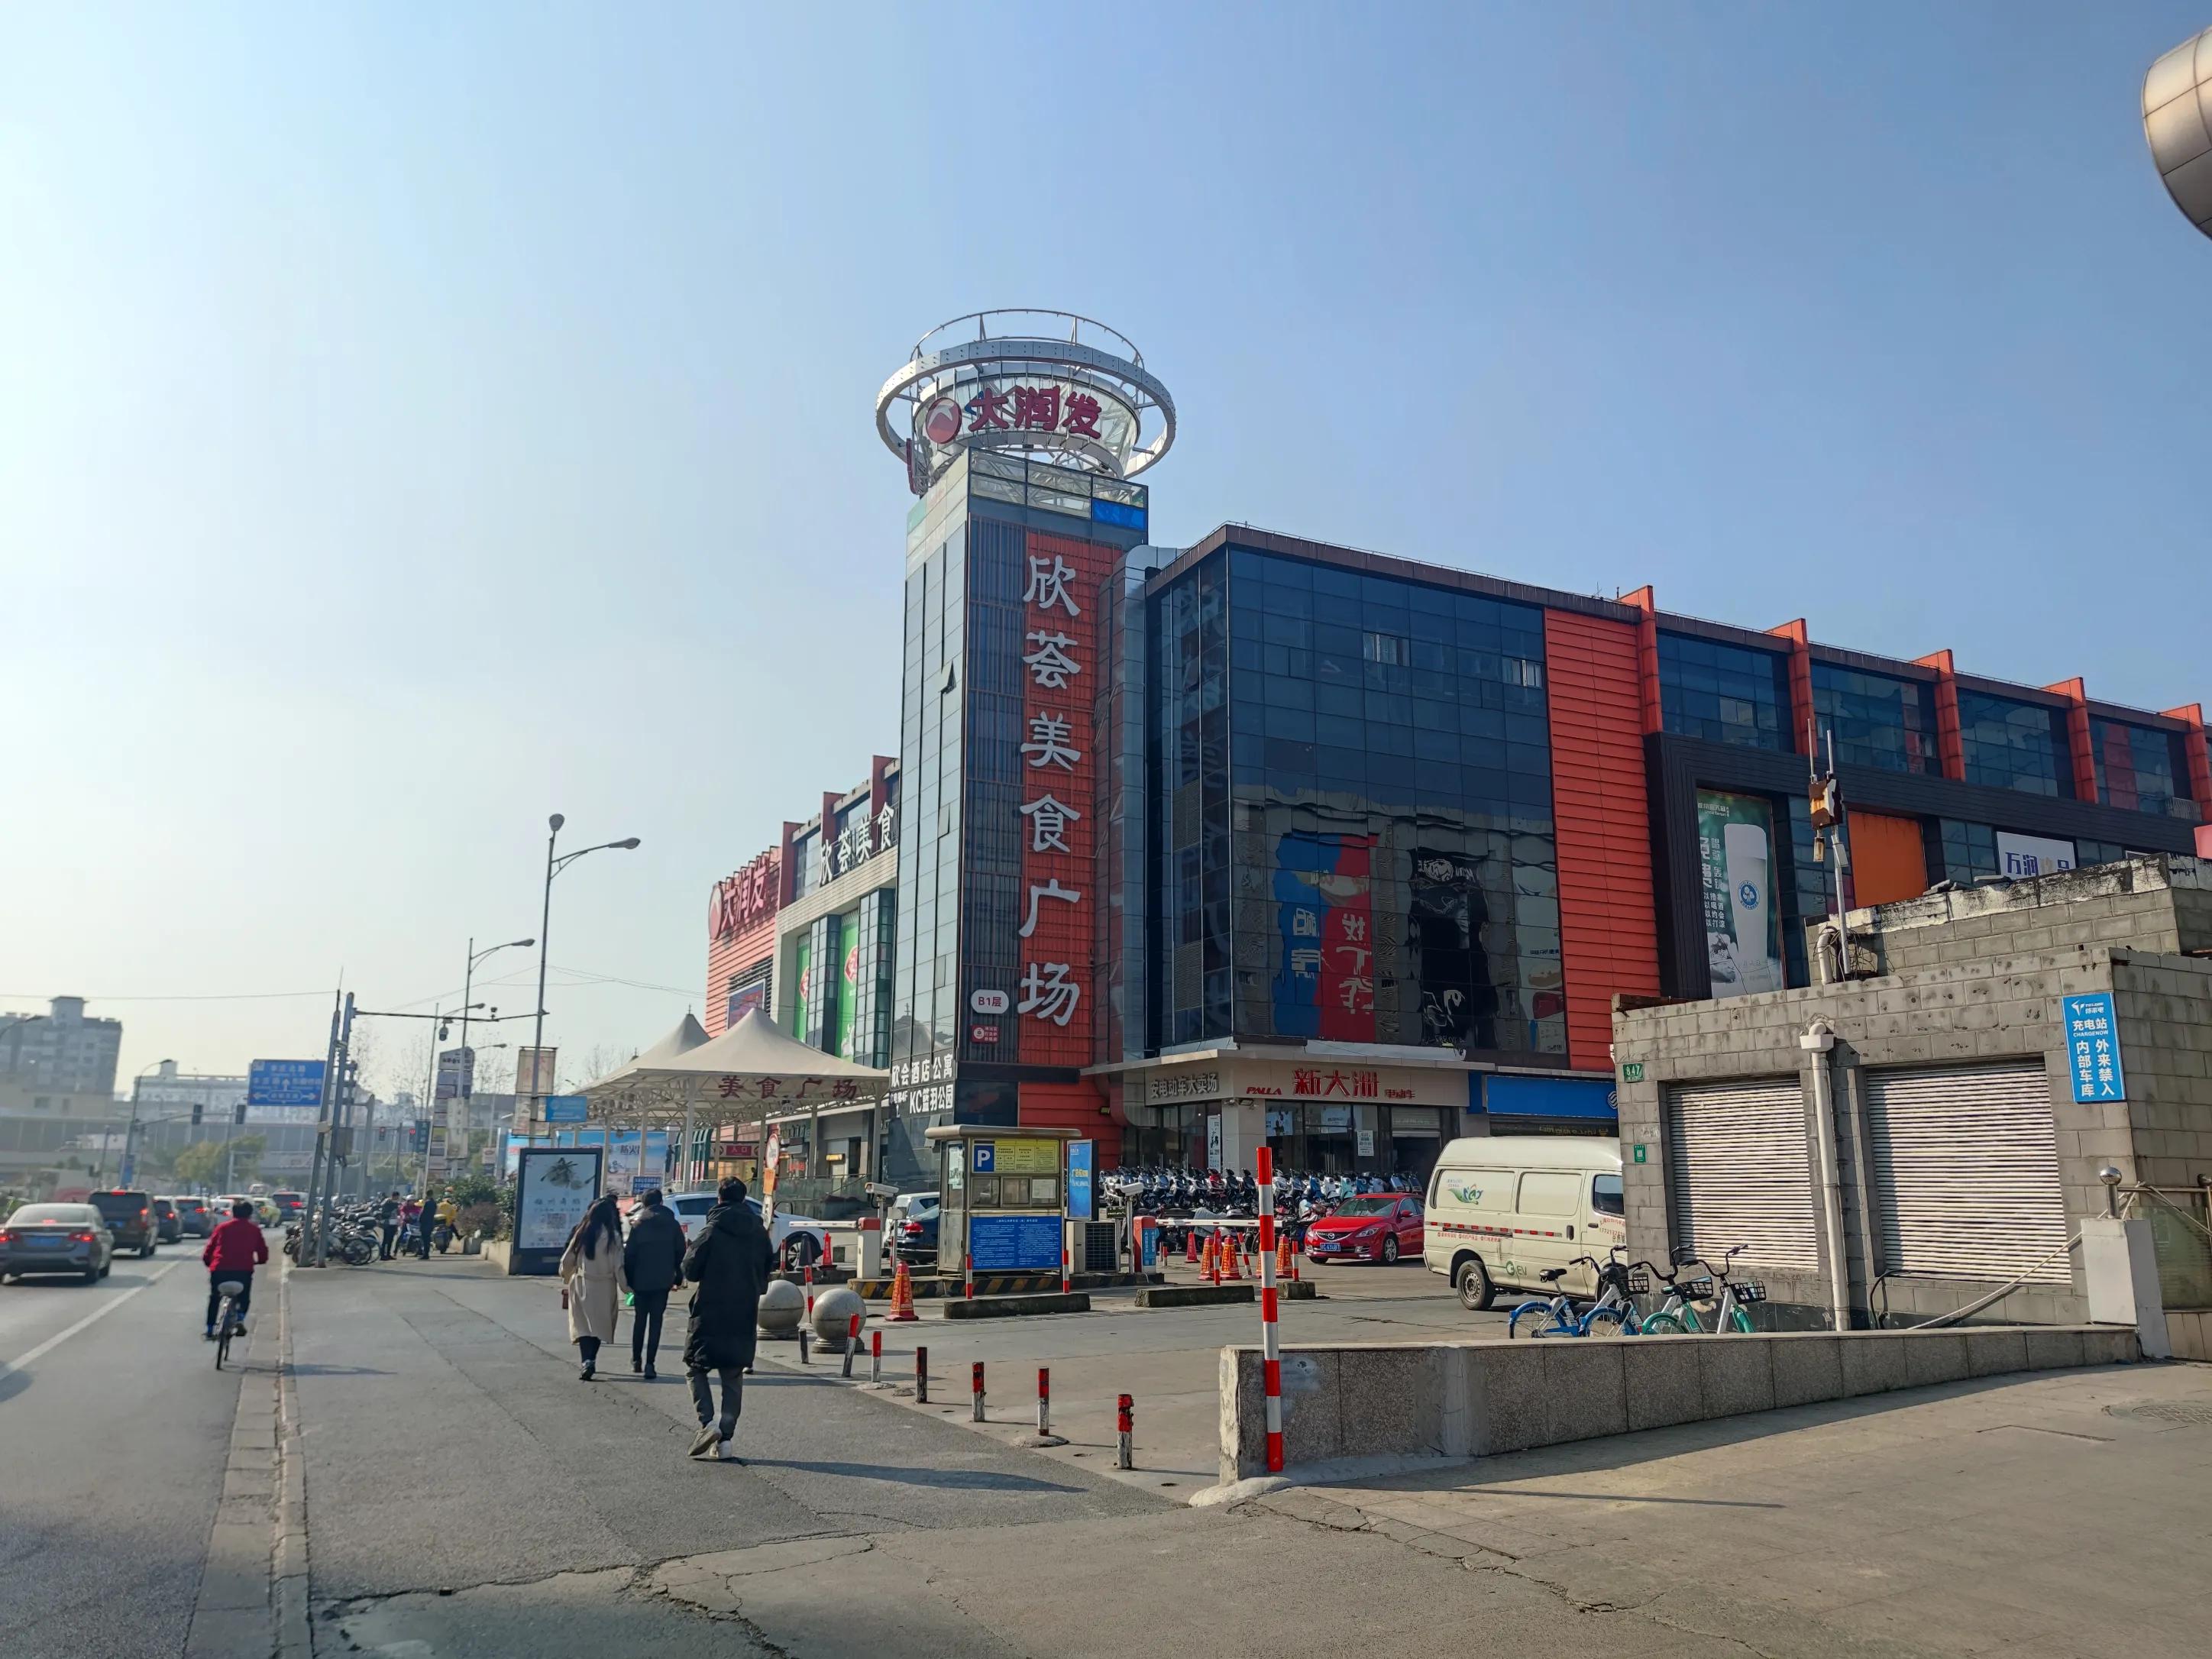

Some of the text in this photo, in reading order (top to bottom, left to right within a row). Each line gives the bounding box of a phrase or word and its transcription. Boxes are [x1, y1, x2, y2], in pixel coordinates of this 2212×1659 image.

[968, 385, 1102, 440] 大润发
[1017, 555, 1082, 1027] 欣荟美食广场
[819, 802, 894, 888] 欣荟美食
[978, 996, 1002, 1007] B1层
[2072, 1018, 2107, 1031] 充电站
[719, 1075, 858, 1100] 美食广场
[1292, 1068, 1379, 1098] 新大洲
[2076, 1041, 2094, 1097] 内部车库
[2095, 1039, 2114, 1096] 外来禁入
[978, 1150, 991, 1167] P
